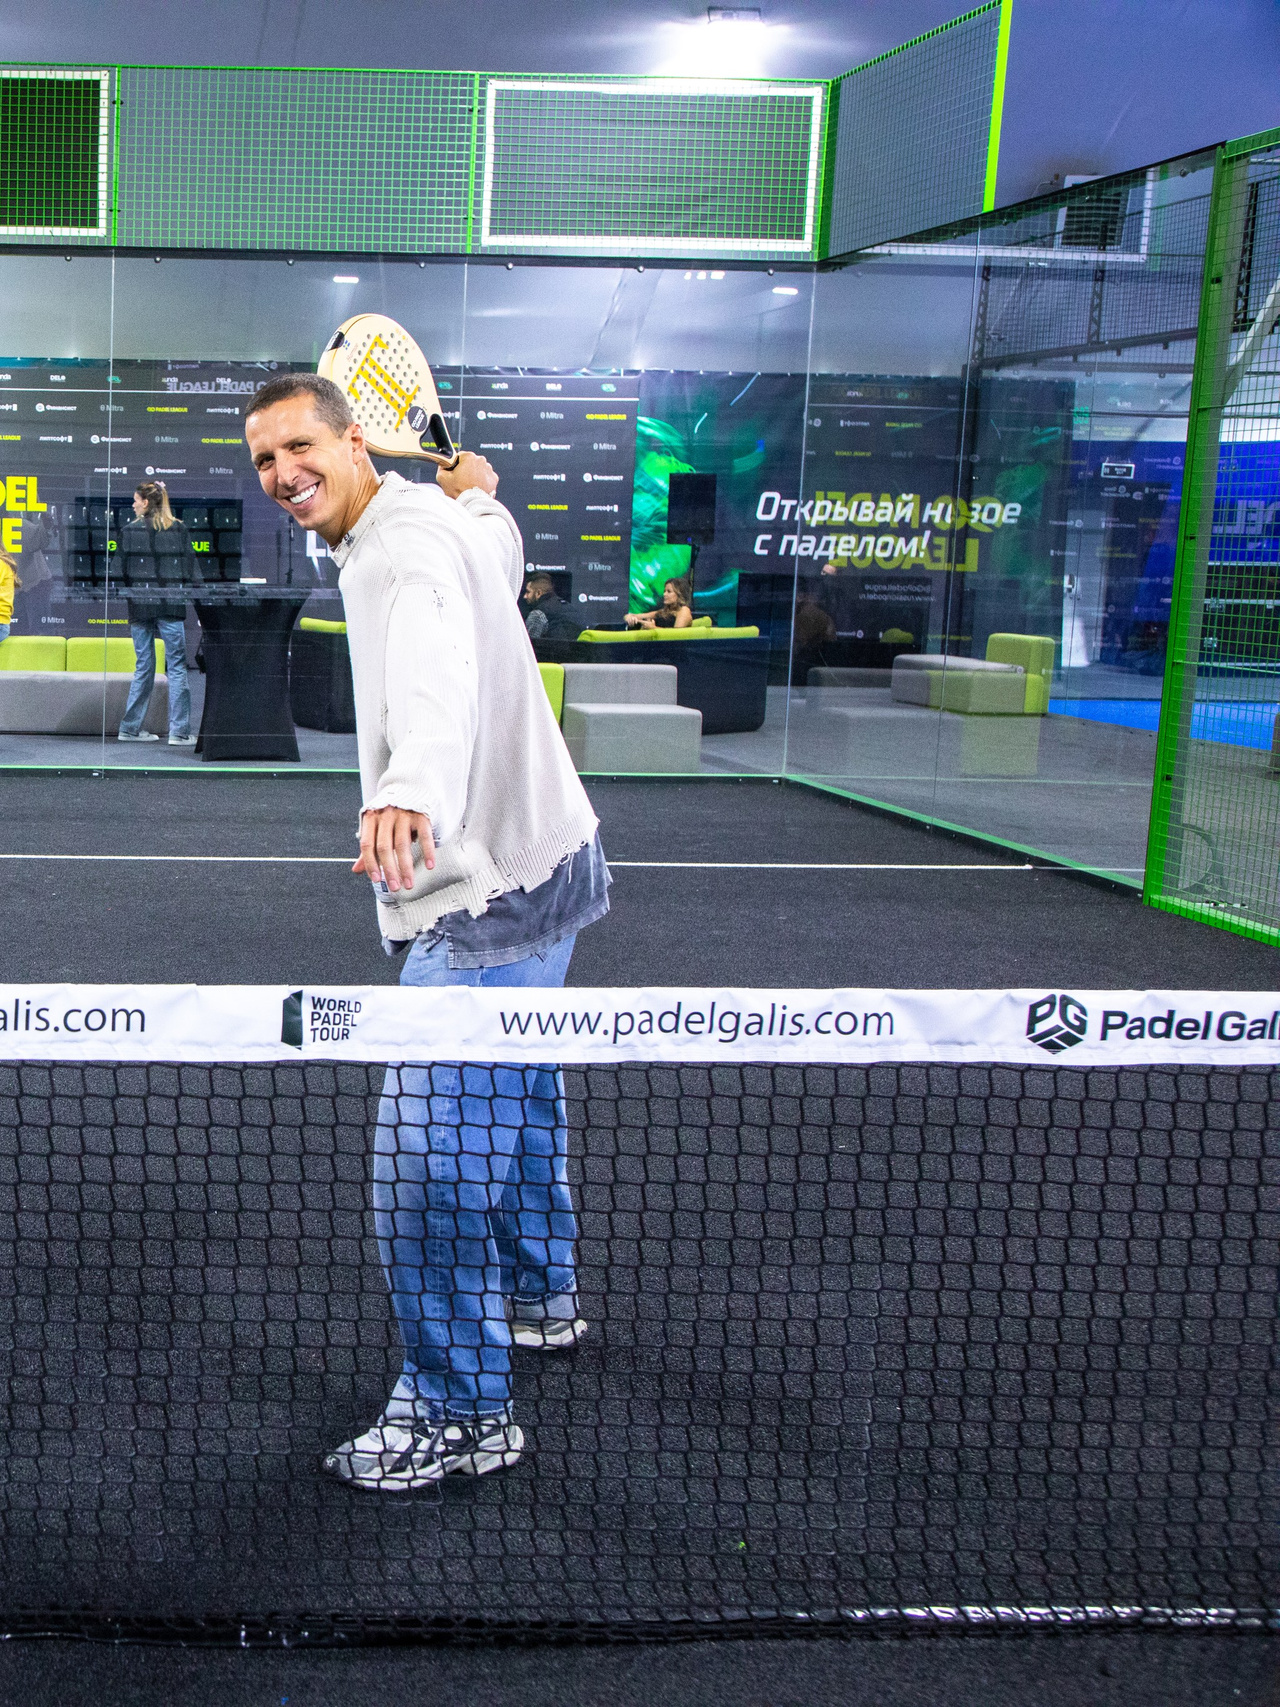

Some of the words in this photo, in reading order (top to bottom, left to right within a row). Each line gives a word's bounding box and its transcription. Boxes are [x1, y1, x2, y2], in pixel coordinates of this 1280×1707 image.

[160, 435, 179, 443] Mitra
[755, 490, 914, 528] Открывай
[922, 502, 1022, 524] нвое
[540, 533, 559, 541] Mitra
[779, 530, 932, 560] паделом!
[588, 594, 618, 602] Финансист
[47, 616, 65, 624] Mitra
[311, 995, 362, 1014] WORLD
[310, 1012, 358, 1028] PADEL
[500, 1000, 895, 1044] www.padelgalis.com
[1101, 1009, 1280, 1041] PadelGal
[310, 1027, 350, 1043] TOUR
